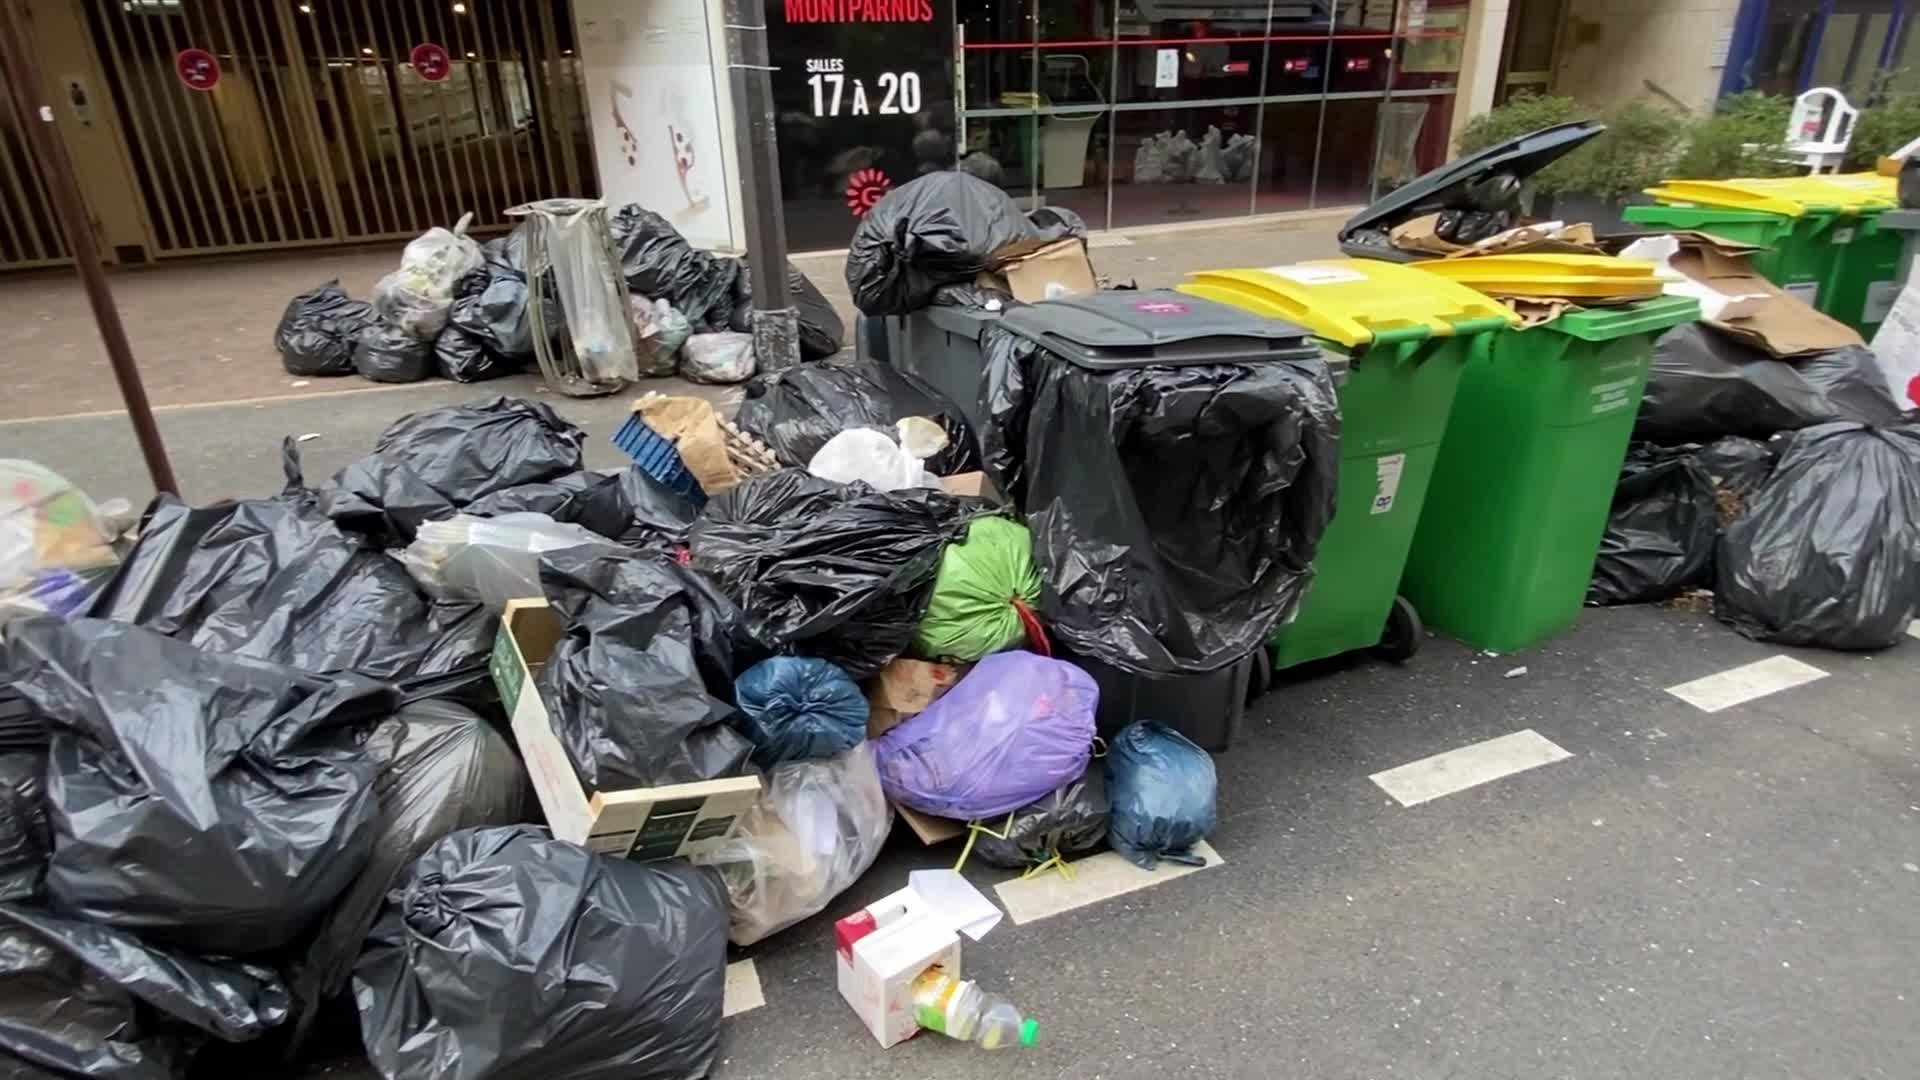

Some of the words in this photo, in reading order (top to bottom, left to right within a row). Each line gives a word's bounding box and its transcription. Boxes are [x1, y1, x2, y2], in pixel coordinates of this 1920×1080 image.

[806, 58, 844, 72] SALLES
[807, 74, 844, 117] 17
[851, 79, 869, 116] À
[877, 72, 921, 115] 20
